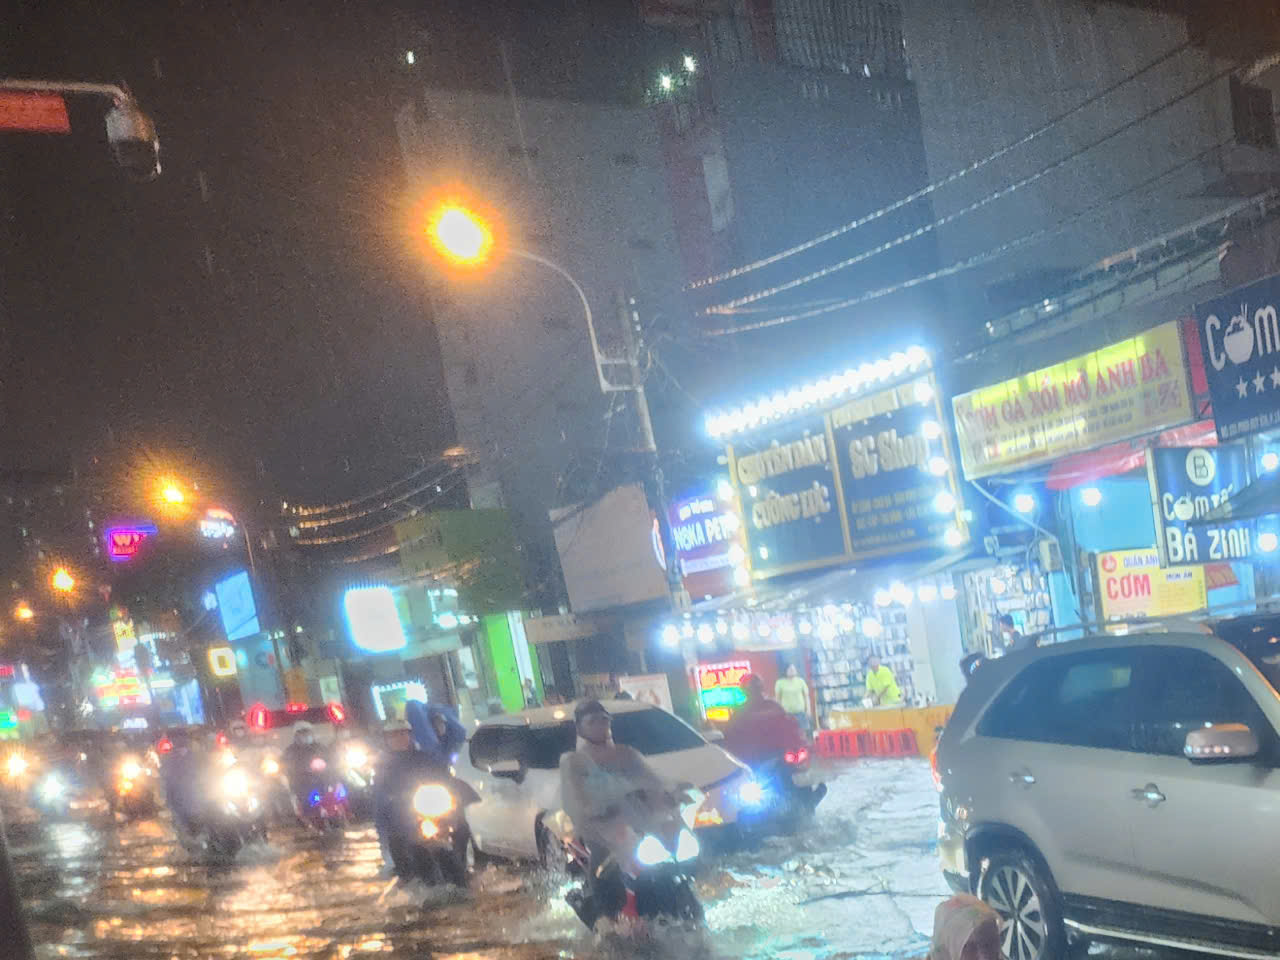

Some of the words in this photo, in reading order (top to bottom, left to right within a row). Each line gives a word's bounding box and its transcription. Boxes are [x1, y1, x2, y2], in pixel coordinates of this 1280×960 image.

[1095, 359, 1136, 398] ANH
[1139, 349, 1169, 382] BA
[1165, 526, 1198, 562] BÀ
[1207, 528, 1250, 560] ZINH
[1106, 573, 1152, 600] CƠM
